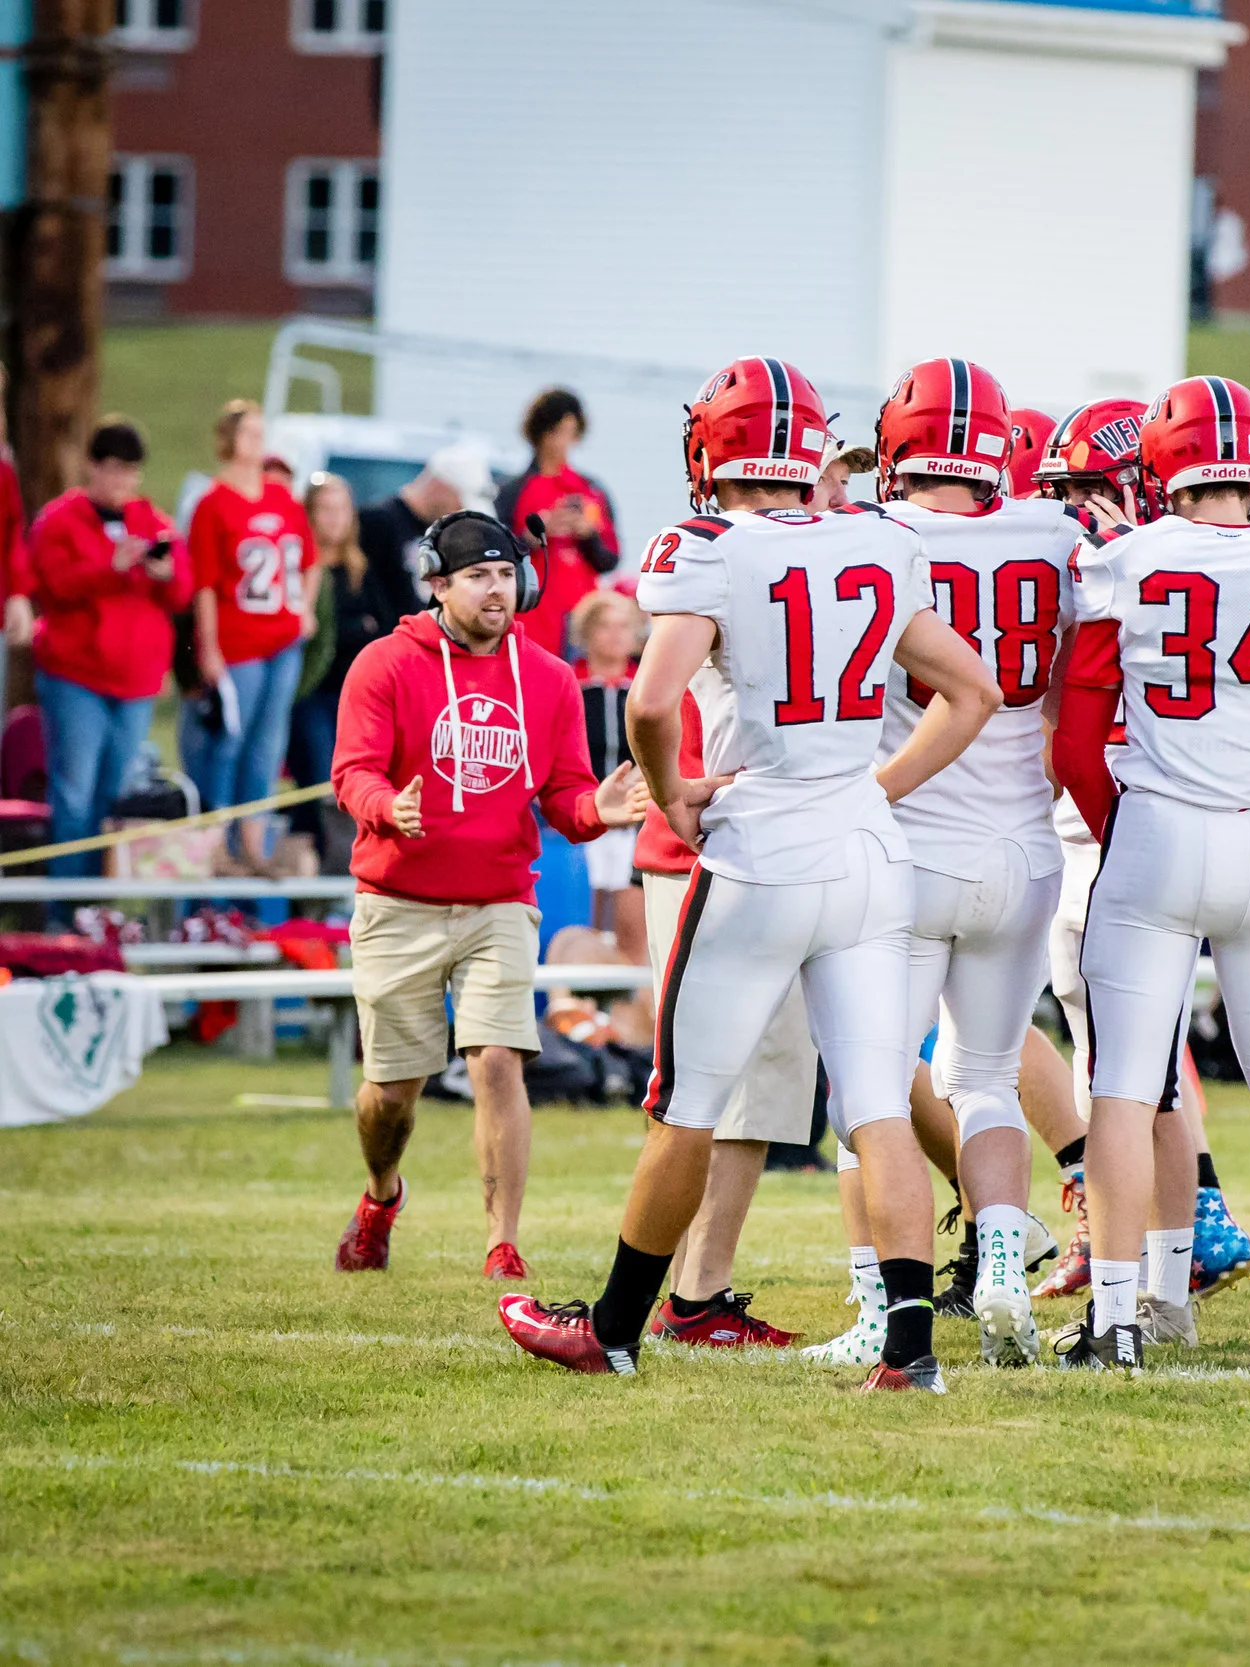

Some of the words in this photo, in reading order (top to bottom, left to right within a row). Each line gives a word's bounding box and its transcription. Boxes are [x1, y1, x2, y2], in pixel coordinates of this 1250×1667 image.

[742, 462, 809, 479] Riddell
[927, 460, 982, 476] Riddell
[640, 532, 682, 574] 12
[769, 563, 895, 727] 12
[991, 1229, 1006, 1287] ARMOUR
[1115, 1327, 1136, 1364] NIKE
